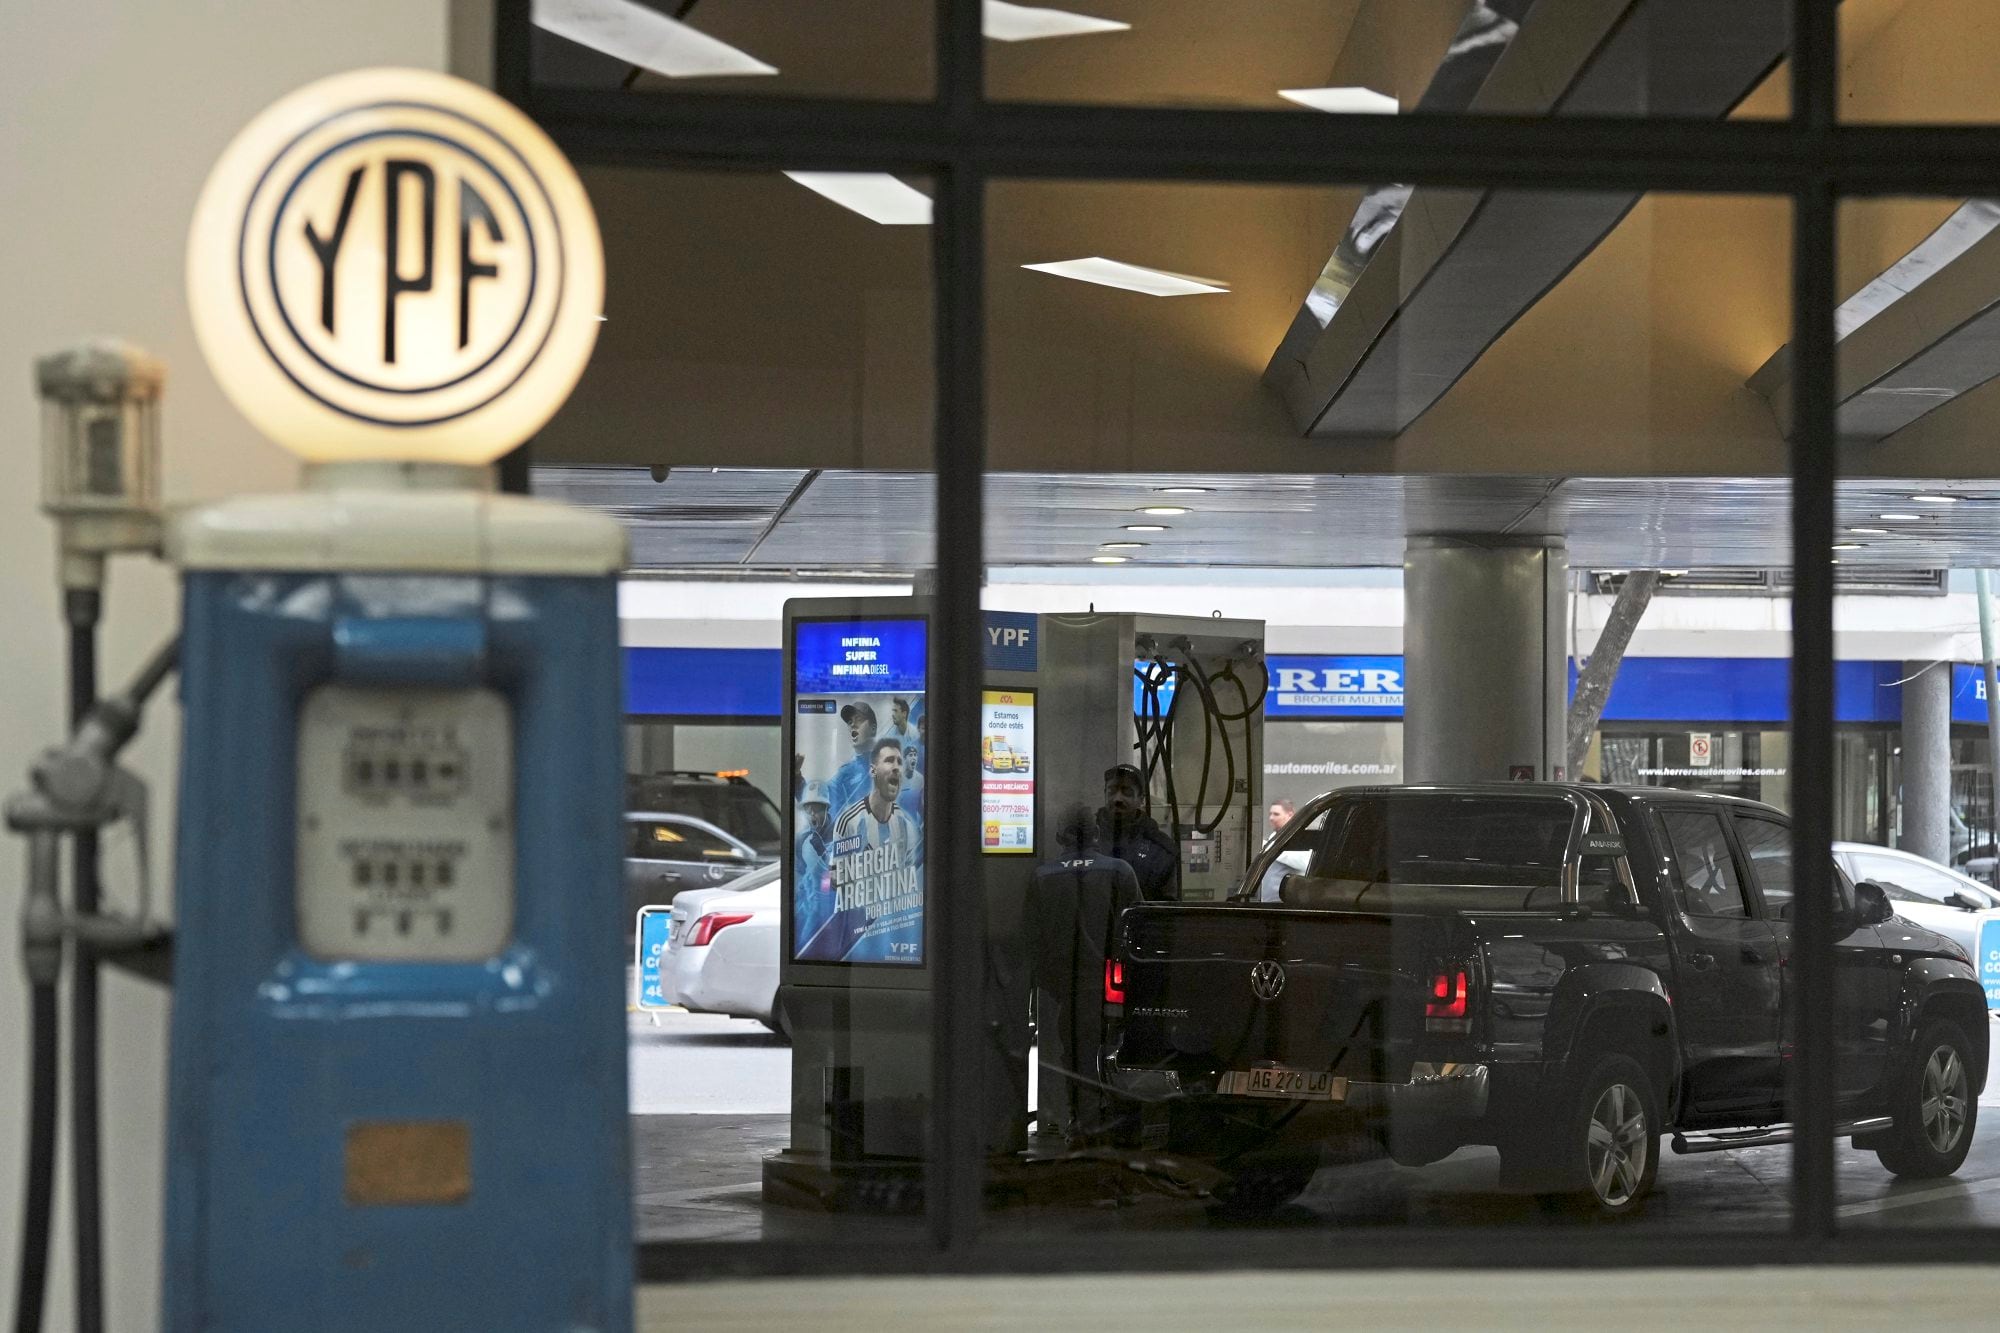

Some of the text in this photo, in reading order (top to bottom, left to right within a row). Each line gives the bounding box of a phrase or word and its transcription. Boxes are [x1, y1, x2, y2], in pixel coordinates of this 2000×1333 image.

[301, 159, 505, 364] YPF
[841, 637, 881, 647] INFINIA
[988, 627, 1030, 647] YPF
[845, 651, 877, 661] SUPER
[832, 664, 889, 675] INFINIA DIESEL
[1267, 668, 1403, 692] RER
[1294, 695, 1402, 704] BROKER MULTIM
[994, 711, 1019, 720] Estamos
[988, 721, 1024, 729] donde estés
[1637, 766, 1787, 777] www.herreraautomoviles.com.ar
[836, 836, 860, 854] PROMO
[836, 839, 899, 886] ENERGÍA
[1060, 859, 1094, 868] YPF
[834, 865, 918, 914] ARGENTINA
[866, 892, 923, 921] POR EL MUNDO
[890, 942, 918, 953] YPF
[1131, 1006, 1192, 1018] AMAROK
[1252, 1070, 1271, 1089] AG
